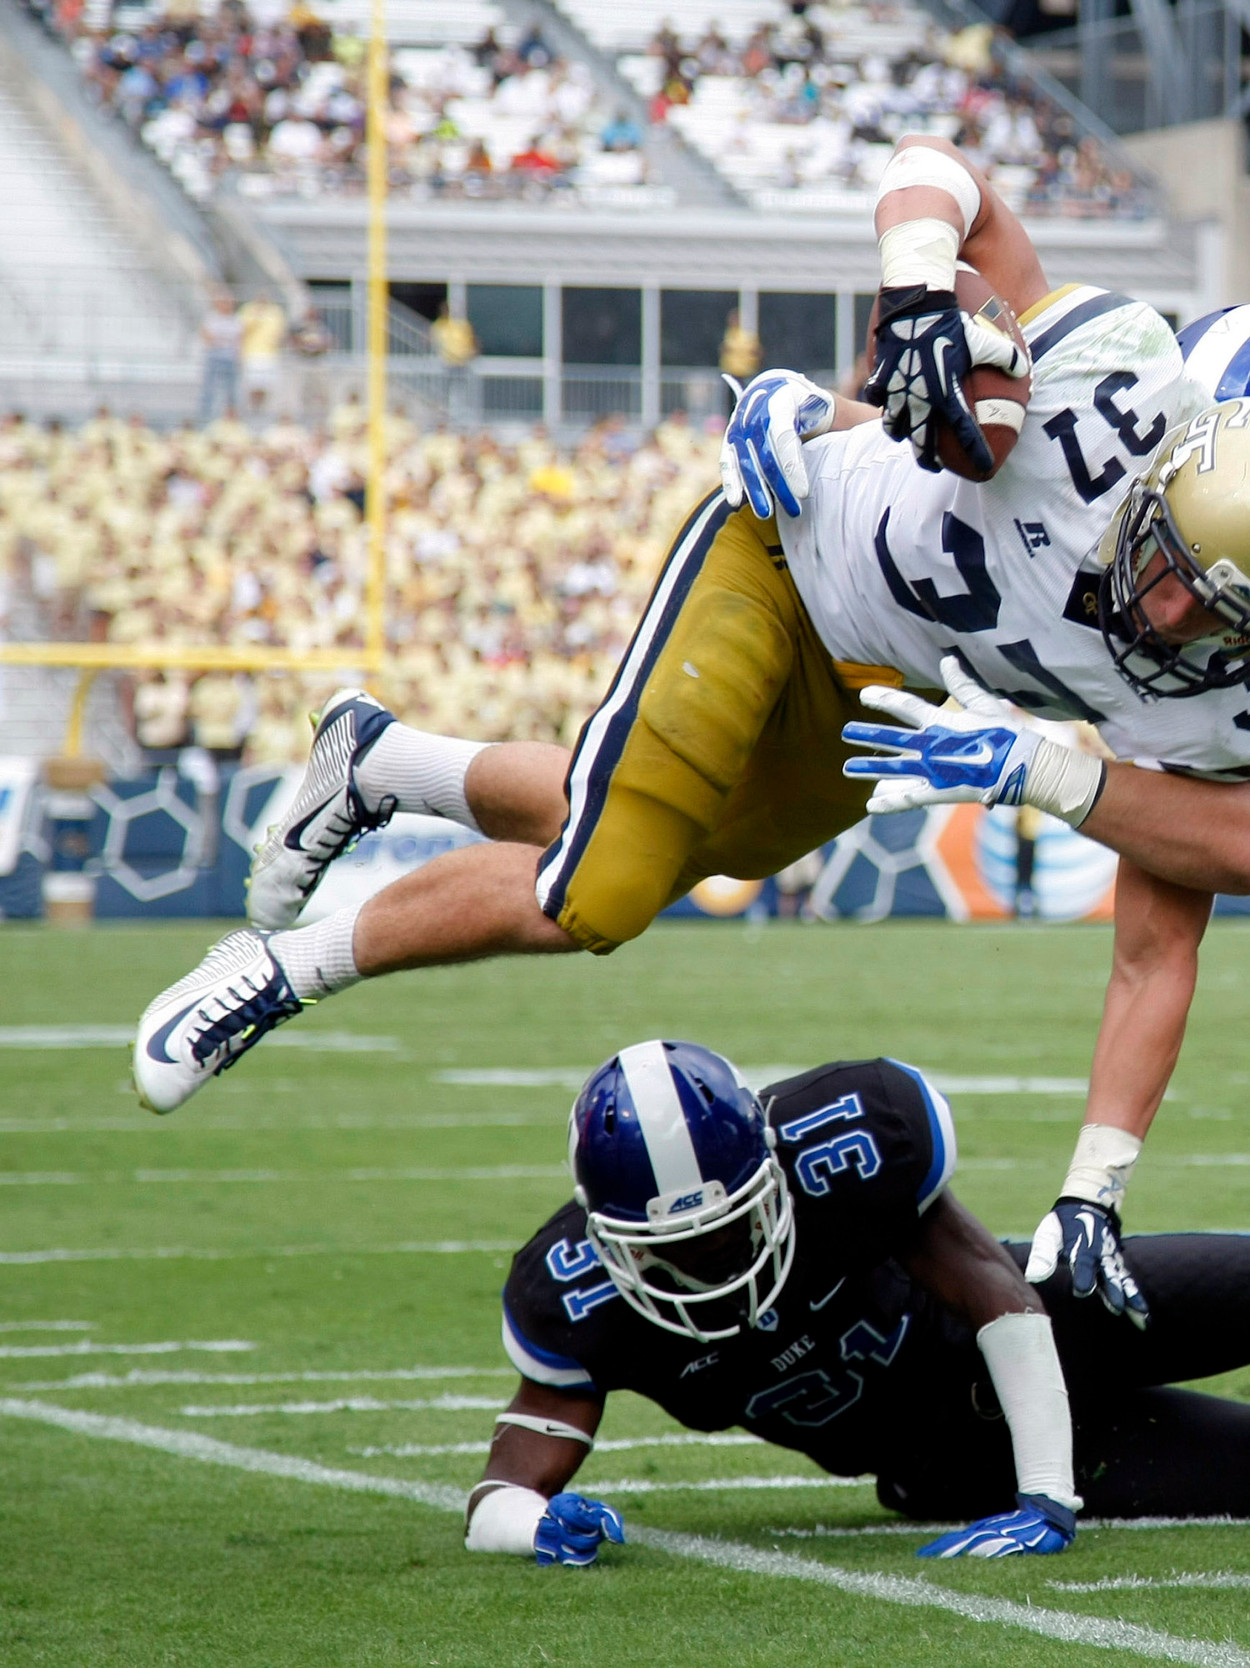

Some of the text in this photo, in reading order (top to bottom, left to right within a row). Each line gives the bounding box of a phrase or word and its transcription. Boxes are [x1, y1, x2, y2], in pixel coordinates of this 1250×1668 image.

[1042, 371, 1167, 506] 37
[779, 1092, 883, 1197] 31
[667, 1190, 703, 1215] ACC
[679, 1351, 720, 1379] ACC
[770, 1334, 816, 1373] DUKE
